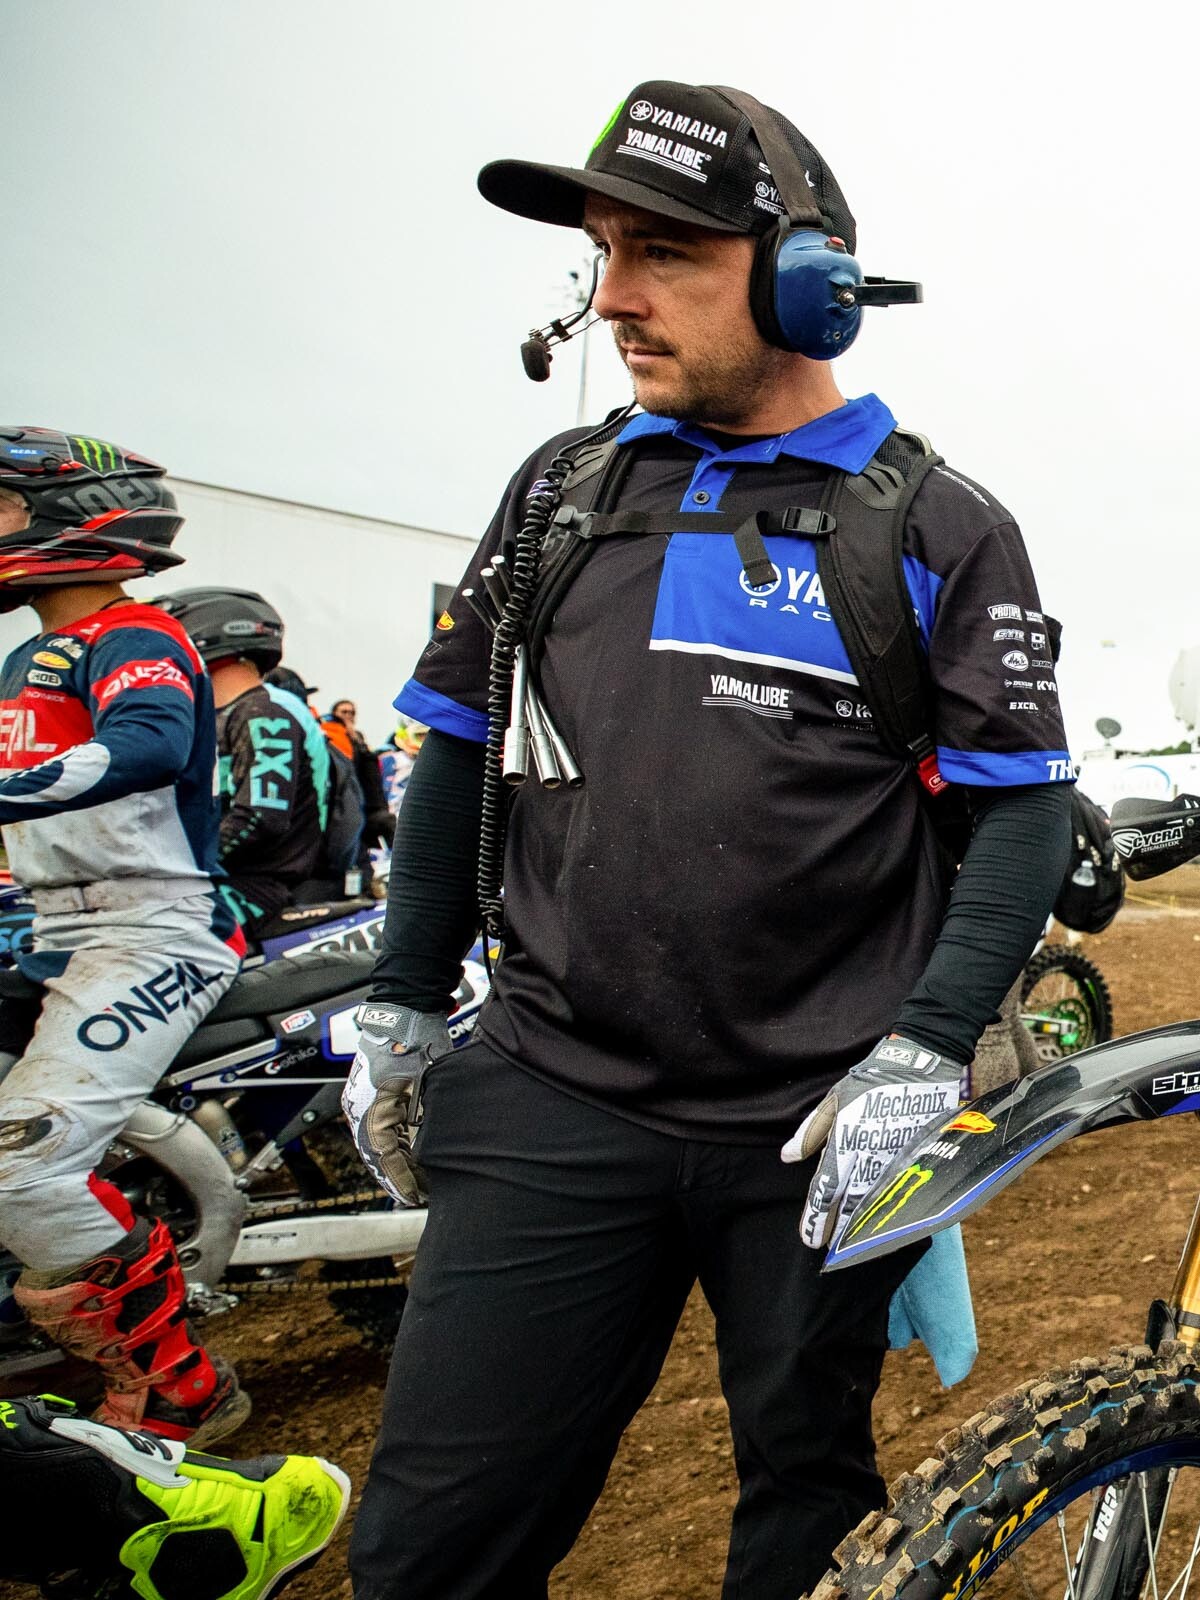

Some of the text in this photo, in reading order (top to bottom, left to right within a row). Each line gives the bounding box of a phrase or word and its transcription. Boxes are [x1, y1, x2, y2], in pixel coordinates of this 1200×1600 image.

[651, 107, 728, 148] YAMAHA
[626, 128, 706, 170] YAMALUBE
[711, 674, 789, 708] YAMALUBE
[1009, 702, 1039, 710] EXCEL
[249, 717, 293, 811] FXR
[1132, 828, 1184, 849] CYCRA
[861, 1086, 947, 1119] Mechanix
[839, 1120, 924, 1152] Mechani
[804, 1175, 830, 1244] VENT
